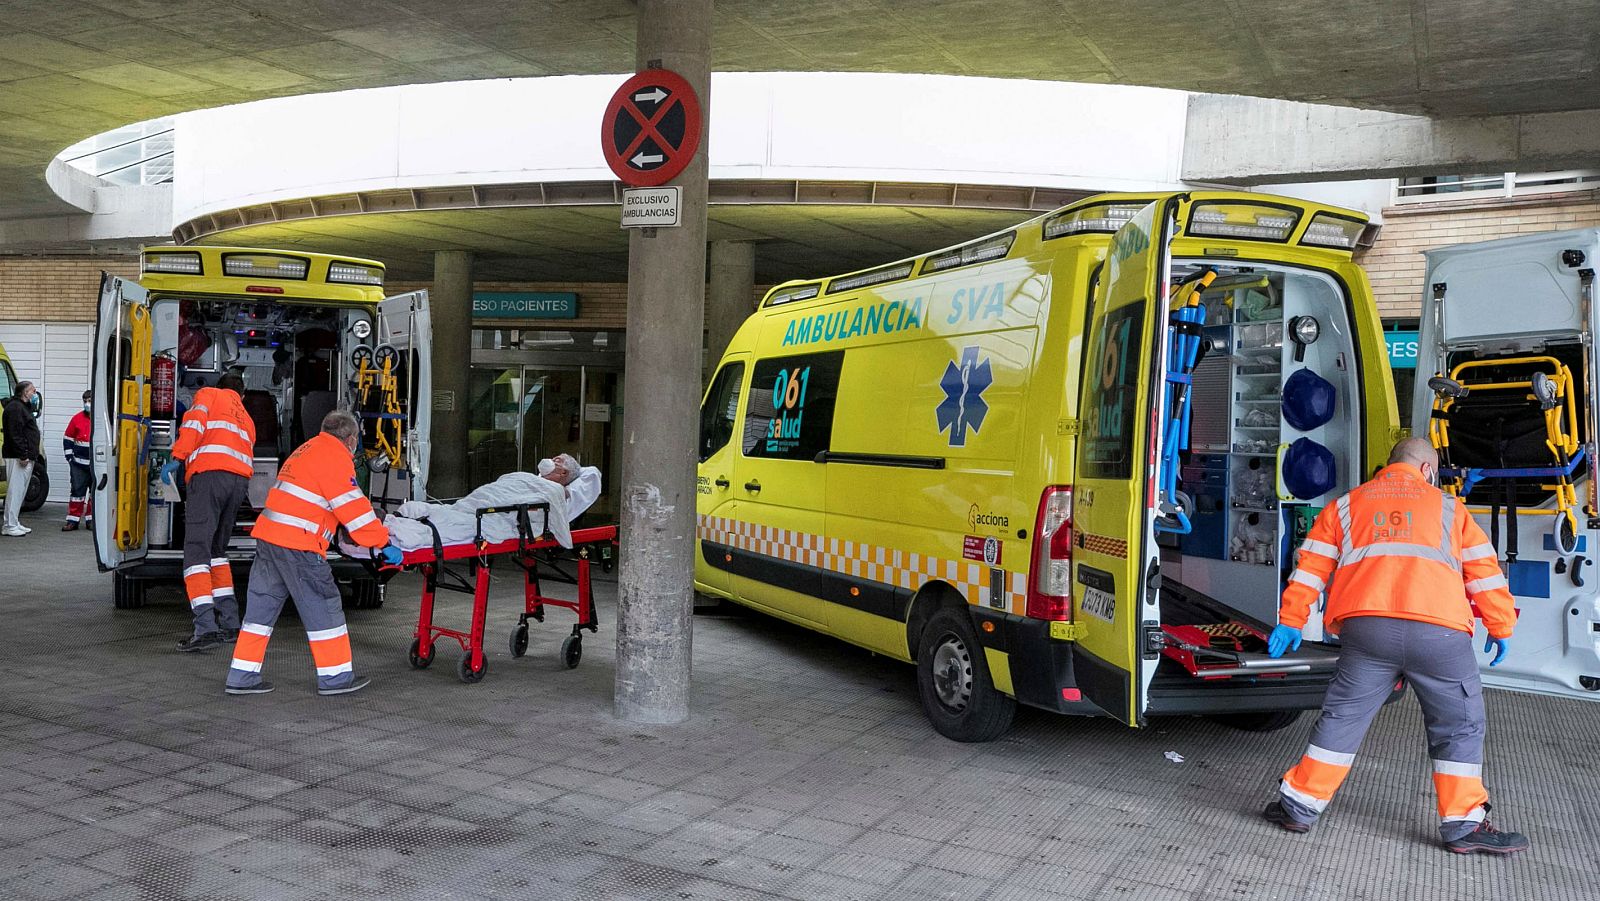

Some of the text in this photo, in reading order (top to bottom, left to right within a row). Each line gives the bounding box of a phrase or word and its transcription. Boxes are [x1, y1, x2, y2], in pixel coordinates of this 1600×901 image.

[627, 195, 670, 206] EXCLUSIVO
[623, 208, 676, 218] AMBULANCIAS
[472, 300, 569, 312] ESO PACIENTES
[782, 282, 1006, 347] AMBULANCIA SVA
[1092, 315, 1134, 394] 061
[772, 366, 811, 410] 061
[768, 410, 803, 438] salud
[976, 511, 1009, 527] acciona
[1373, 510, 1413, 527] 061
